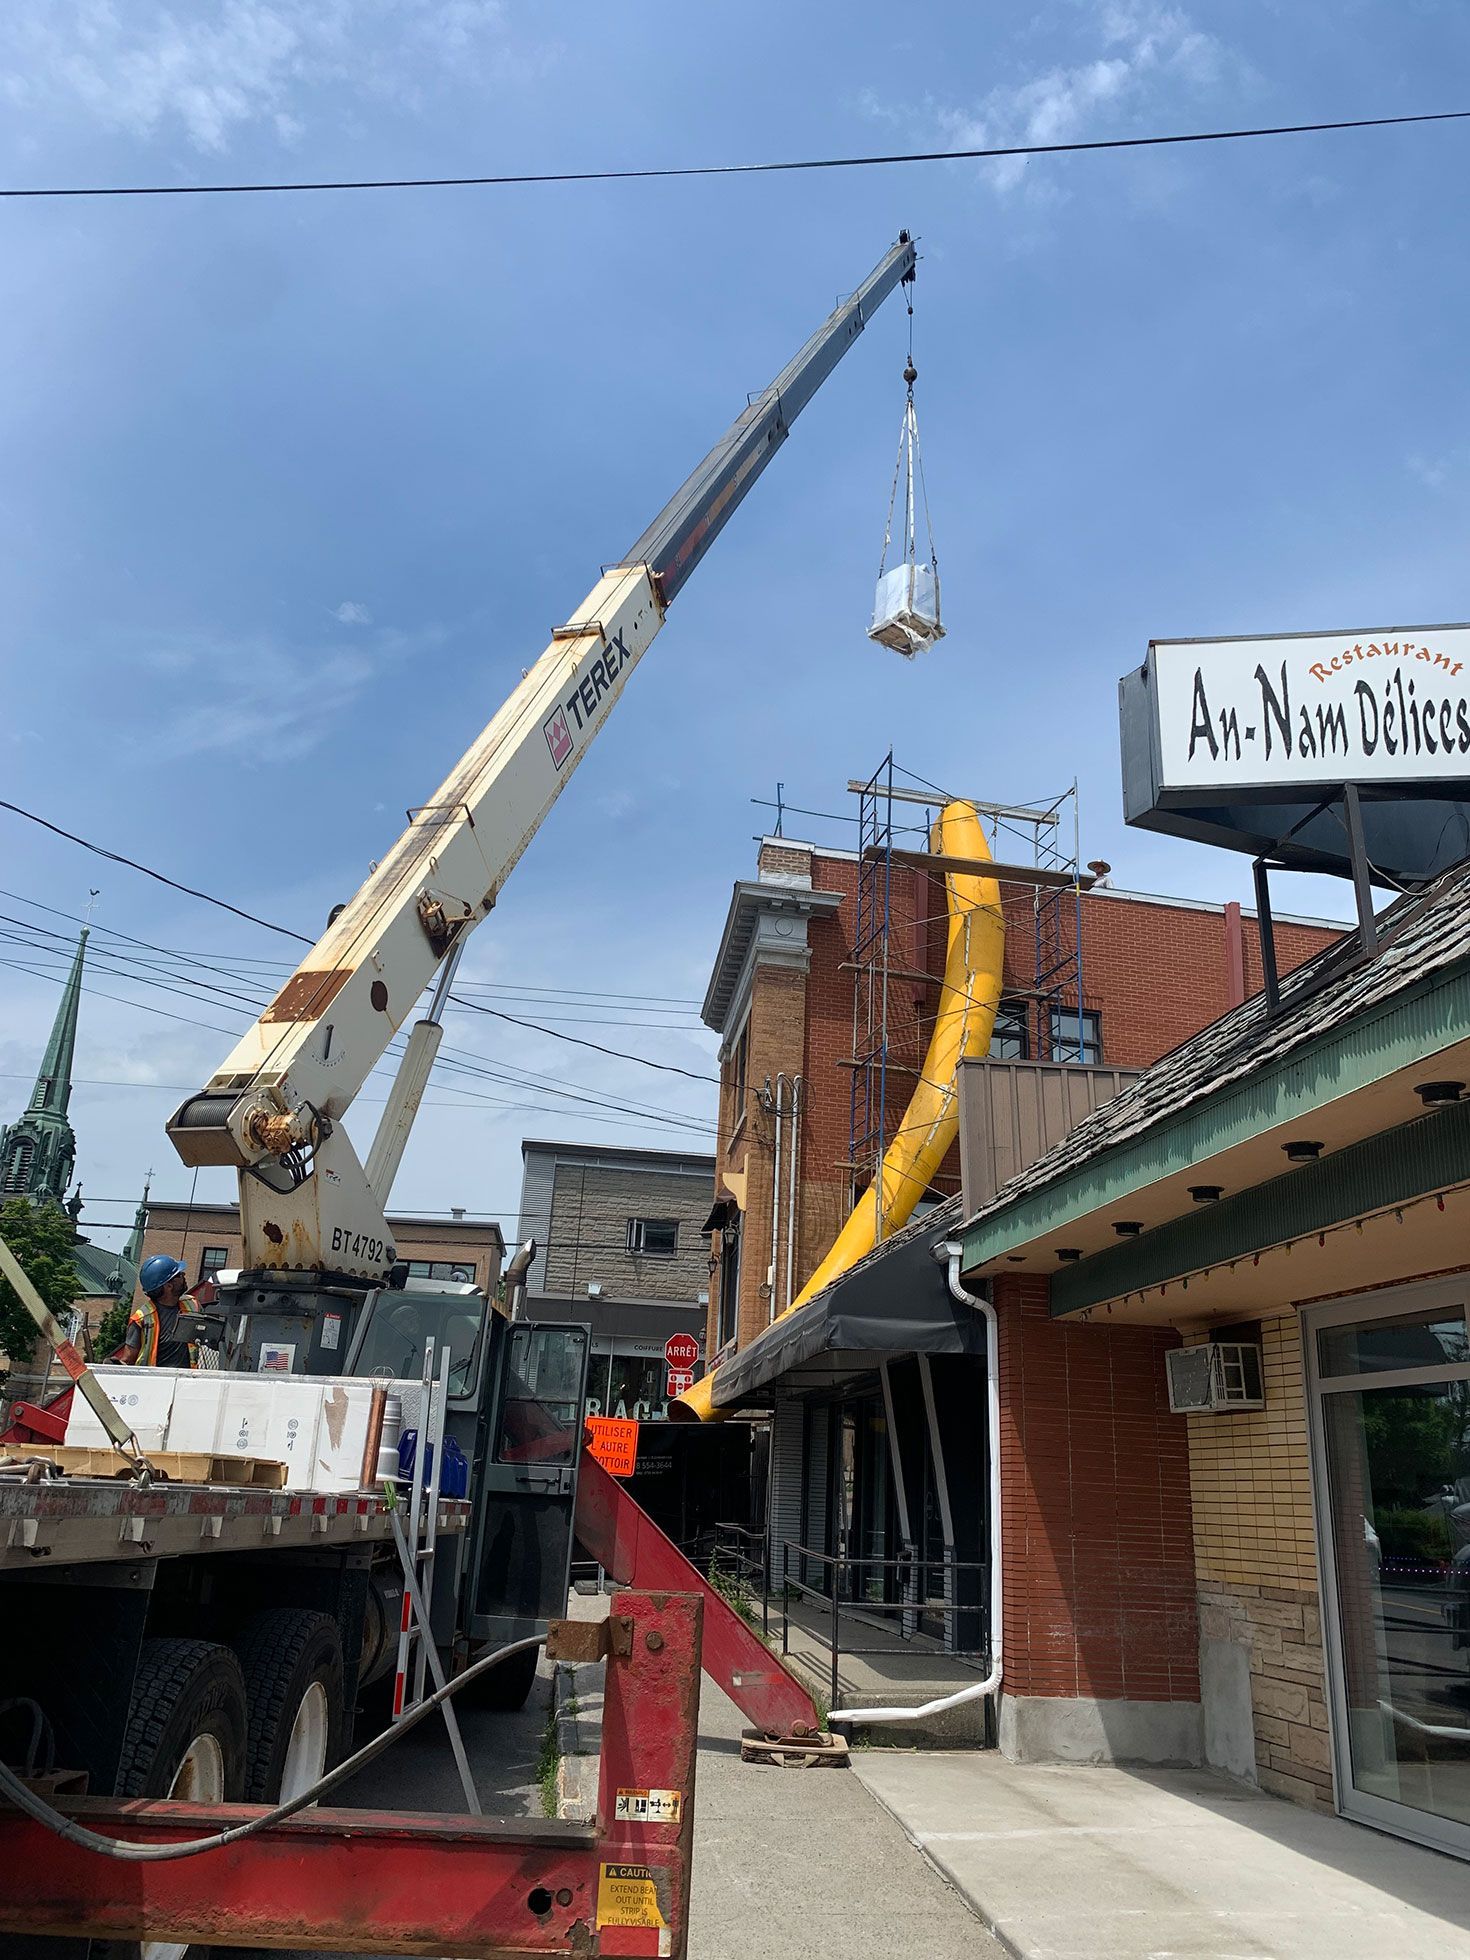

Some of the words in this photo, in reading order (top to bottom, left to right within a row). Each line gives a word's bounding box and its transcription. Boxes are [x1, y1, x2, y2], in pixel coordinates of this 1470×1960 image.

[1308, 641, 1465, 684] Restaurant
[566, 626, 631, 730] TEREX
[1187, 659, 1350, 763] An-Nam
[1353, 667, 1470, 757] Délices
[667, 1345, 697, 1358] ARRÊT
[592, 1424, 632, 1439] UTILISER
[594, 1455, 630, 1469] OTTOIR
[620, 1867, 652, 1878] CAUTI
[610, 1885, 638, 1894] EXTEND
[616, 1895, 631, 1904] OUT
[633, 1896, 654, 1906] UNTIL
[621, 1907, 640, 1915] STRIP
[641, 1907, 648, 1916] IS
